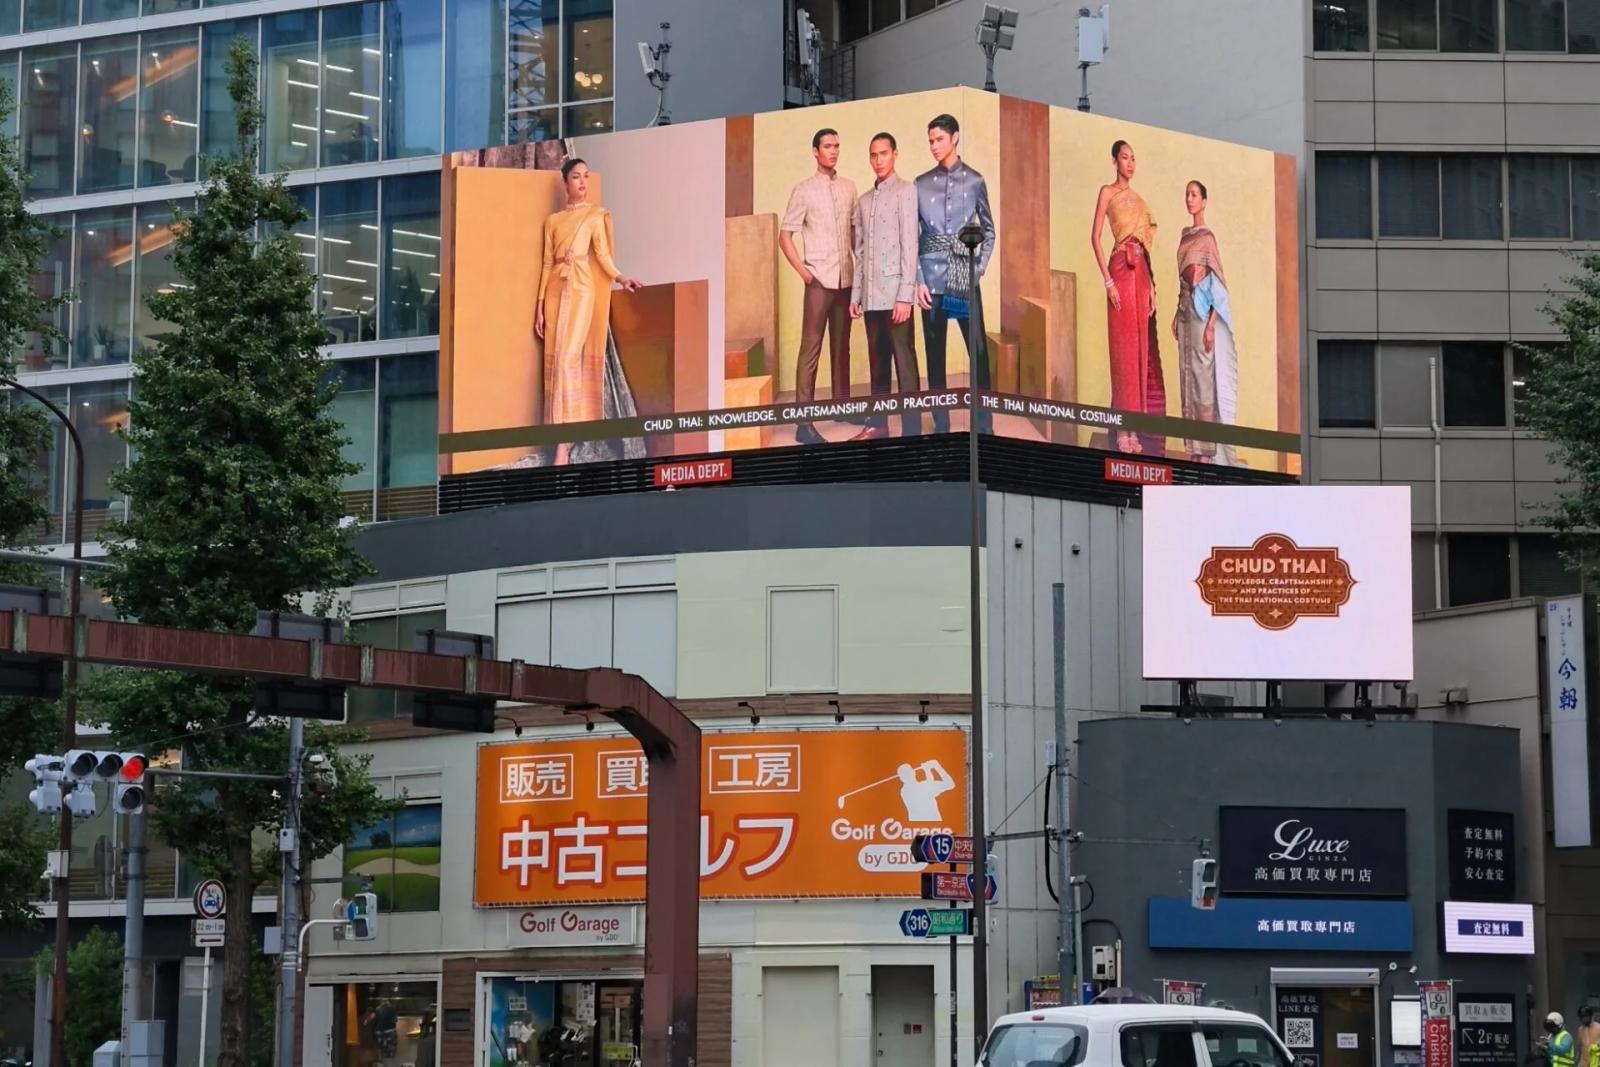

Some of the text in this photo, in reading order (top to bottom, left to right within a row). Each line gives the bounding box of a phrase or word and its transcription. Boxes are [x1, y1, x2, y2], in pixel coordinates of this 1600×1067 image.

[644, 393, 1123, 431] CHUD THAI: KNOWLEDGE, CRAFTSMANSHIP AND PRACTICES O THE THAI NATIONAL COSTUME
[661, 462, 727, 482] MEDIA DEPT.
[1111, 462, 1169, 483] MEDIA DEPT.
[1221, 557, 1326, 574] CHUD THAI
[1269, 578, 1333, 586] CRAFTSMANSHIP
[717, 752, 792, 787] 工房
[506, 761, 566, 797] 販売
[831, 818, 875, 840] Golf
[935, 838, 950, 855] 15
[954, 840, 973, 852] 中央
[1268, 819, 1350, 861] Luxe
[864, 852, 882, 867] by
[1254, 866, 1373, 883] 高価買取専門店
[519, 911, 620, 934] Golf Garage
[910, 915, 929, 931] 316
[1257, 919, 1356, 934] 高価買取専門店
[1473, 922, 1510, 935] 査定無料
[1278, 1004, 1301, 1013] LINE
